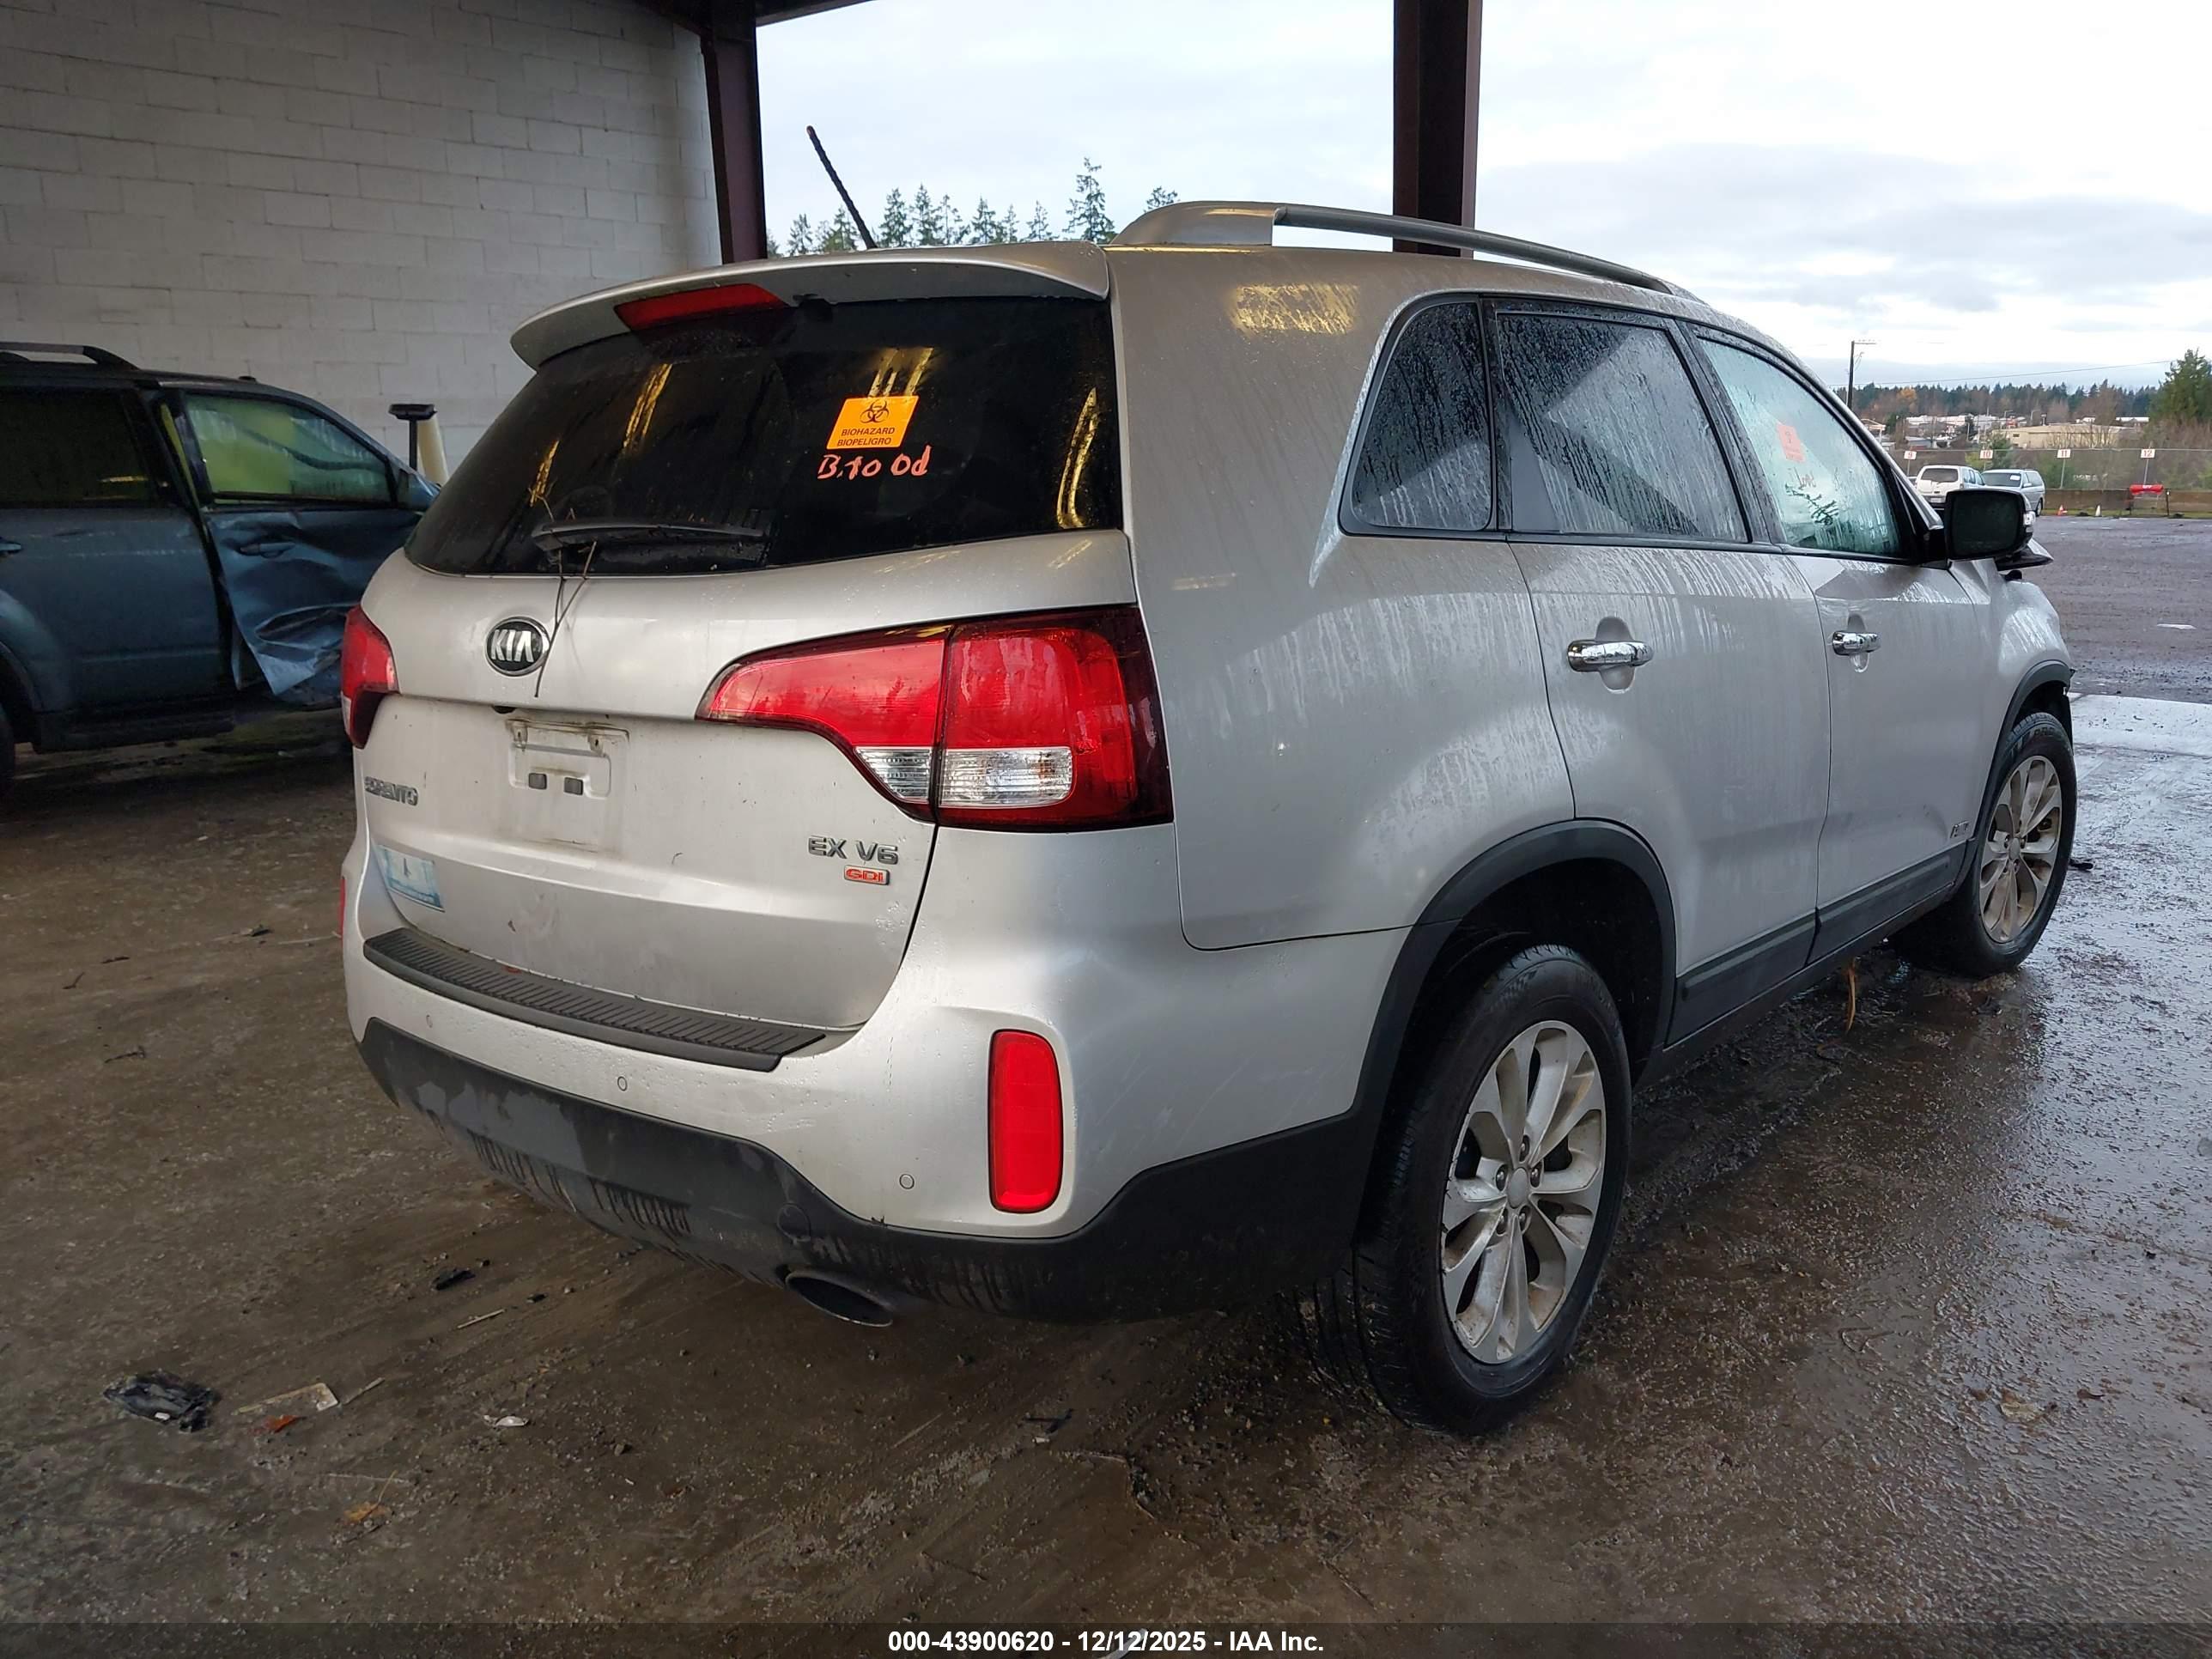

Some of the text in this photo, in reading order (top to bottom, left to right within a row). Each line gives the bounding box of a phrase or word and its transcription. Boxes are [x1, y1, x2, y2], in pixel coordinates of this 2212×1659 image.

[842, 428, 896, 436] BIOHAZARD
[837, 438, 892, 447] BIOPELIGRO
[490, 629, 534, 662] KIA
[808, 836, 899, 865] EX V6
